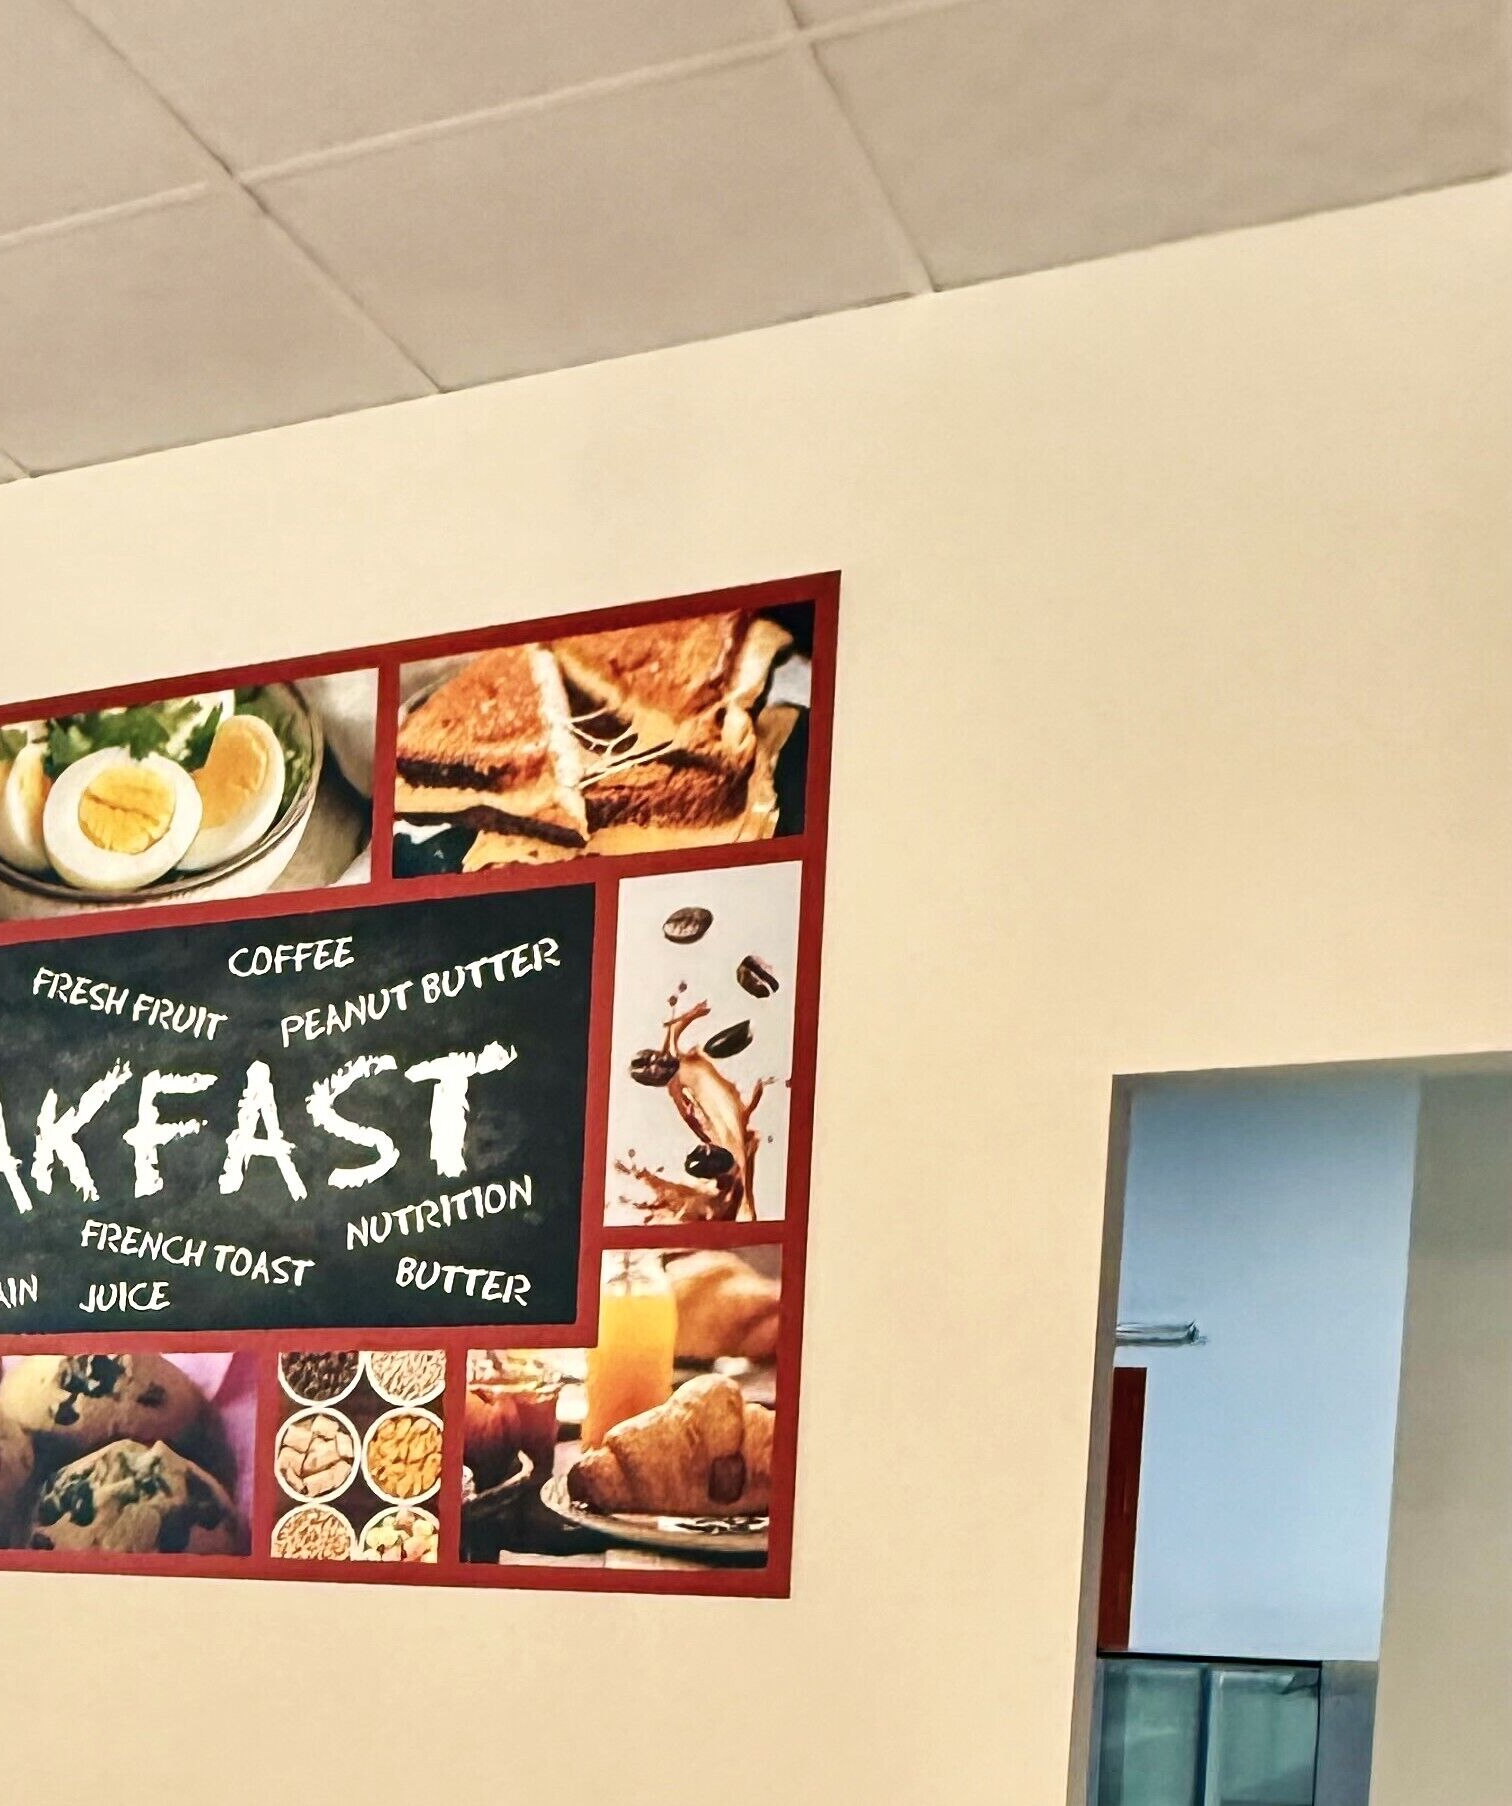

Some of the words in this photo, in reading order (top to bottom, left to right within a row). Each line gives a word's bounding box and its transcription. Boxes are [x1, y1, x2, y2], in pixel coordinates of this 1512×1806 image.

[228, 935, 355, 978] COFFEE
[32, 966, 130, 1015] FRESH
[132, 993, 229, 1041] FRUIT
[280, 980, 414, 1048] PEANUT
[421, 937, 561, 1004] BUTTER
[345, 1174, 533, 1251] NUTRITION
[80, 1219, 207, 1268] FRENCH
[213, 1244, 316, 1287] TOAST
[395, 1256, 532, 1307] BUTTER
[78, 1281, 171, 1313] JUICE
